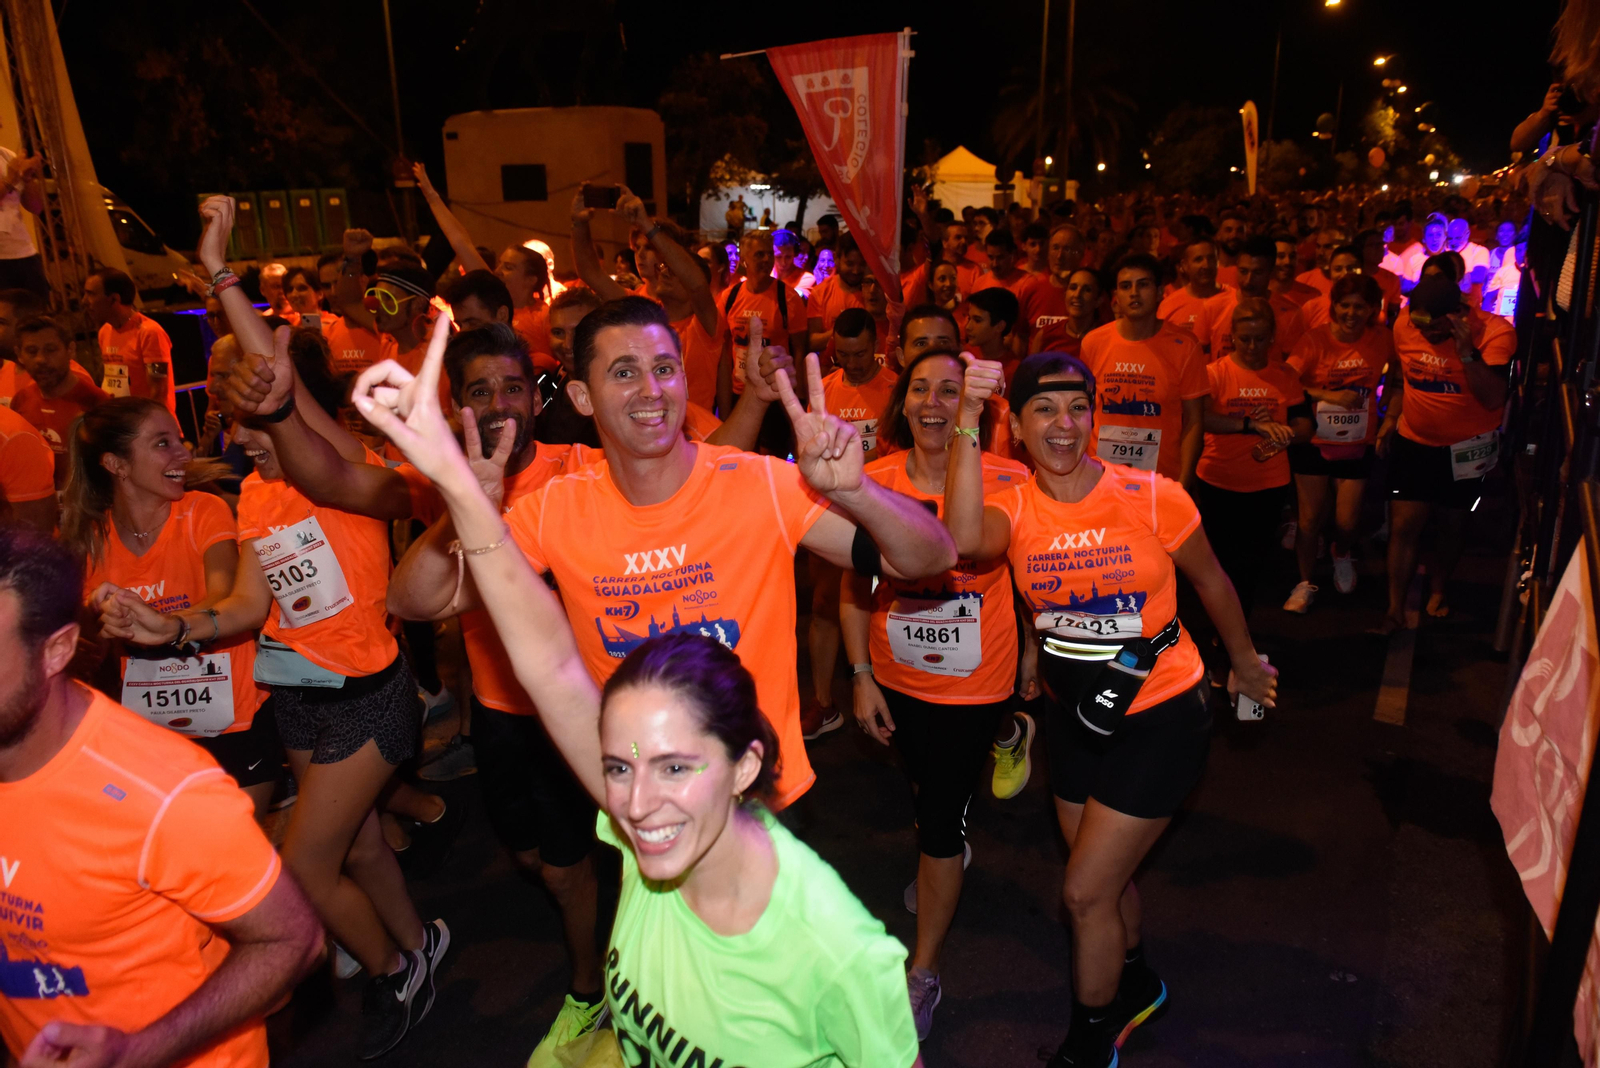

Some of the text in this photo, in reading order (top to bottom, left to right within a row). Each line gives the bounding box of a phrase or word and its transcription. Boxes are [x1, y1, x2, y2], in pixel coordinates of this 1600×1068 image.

[342, 349, 366, 359] XXXV
[1419, 352, 1449, 368] XXXV
[1114, 361, 1146, 373] XXXV
[1337, 358, 1364, 369] XXXV
[1239, 387, 1268, 397] XXXV
[839, 408, 867, 418] XXXV
[1326, 414, 1360, 425] 18080
[1111, 444, 1144, 457] 7914
[1048, 527, 1106, 551] XXXV
[623, 543, 687, 576] XXXV
[1027, 544, 1131, 562] CARRERA NOCTURNA
[592, 561, 712, 584] CARRERA NOCTURNA
[1032, 553, 1133, 574] GUADALQUIVIR
[266, 558, 318, 592] 5103
[601, 571, 715, 597] GUADALQUIVIR
[902, 625, 960, 643] 14861
[141, 686, 213, 708] 15104
[606, 946, 751, 1068] RUNNIN
